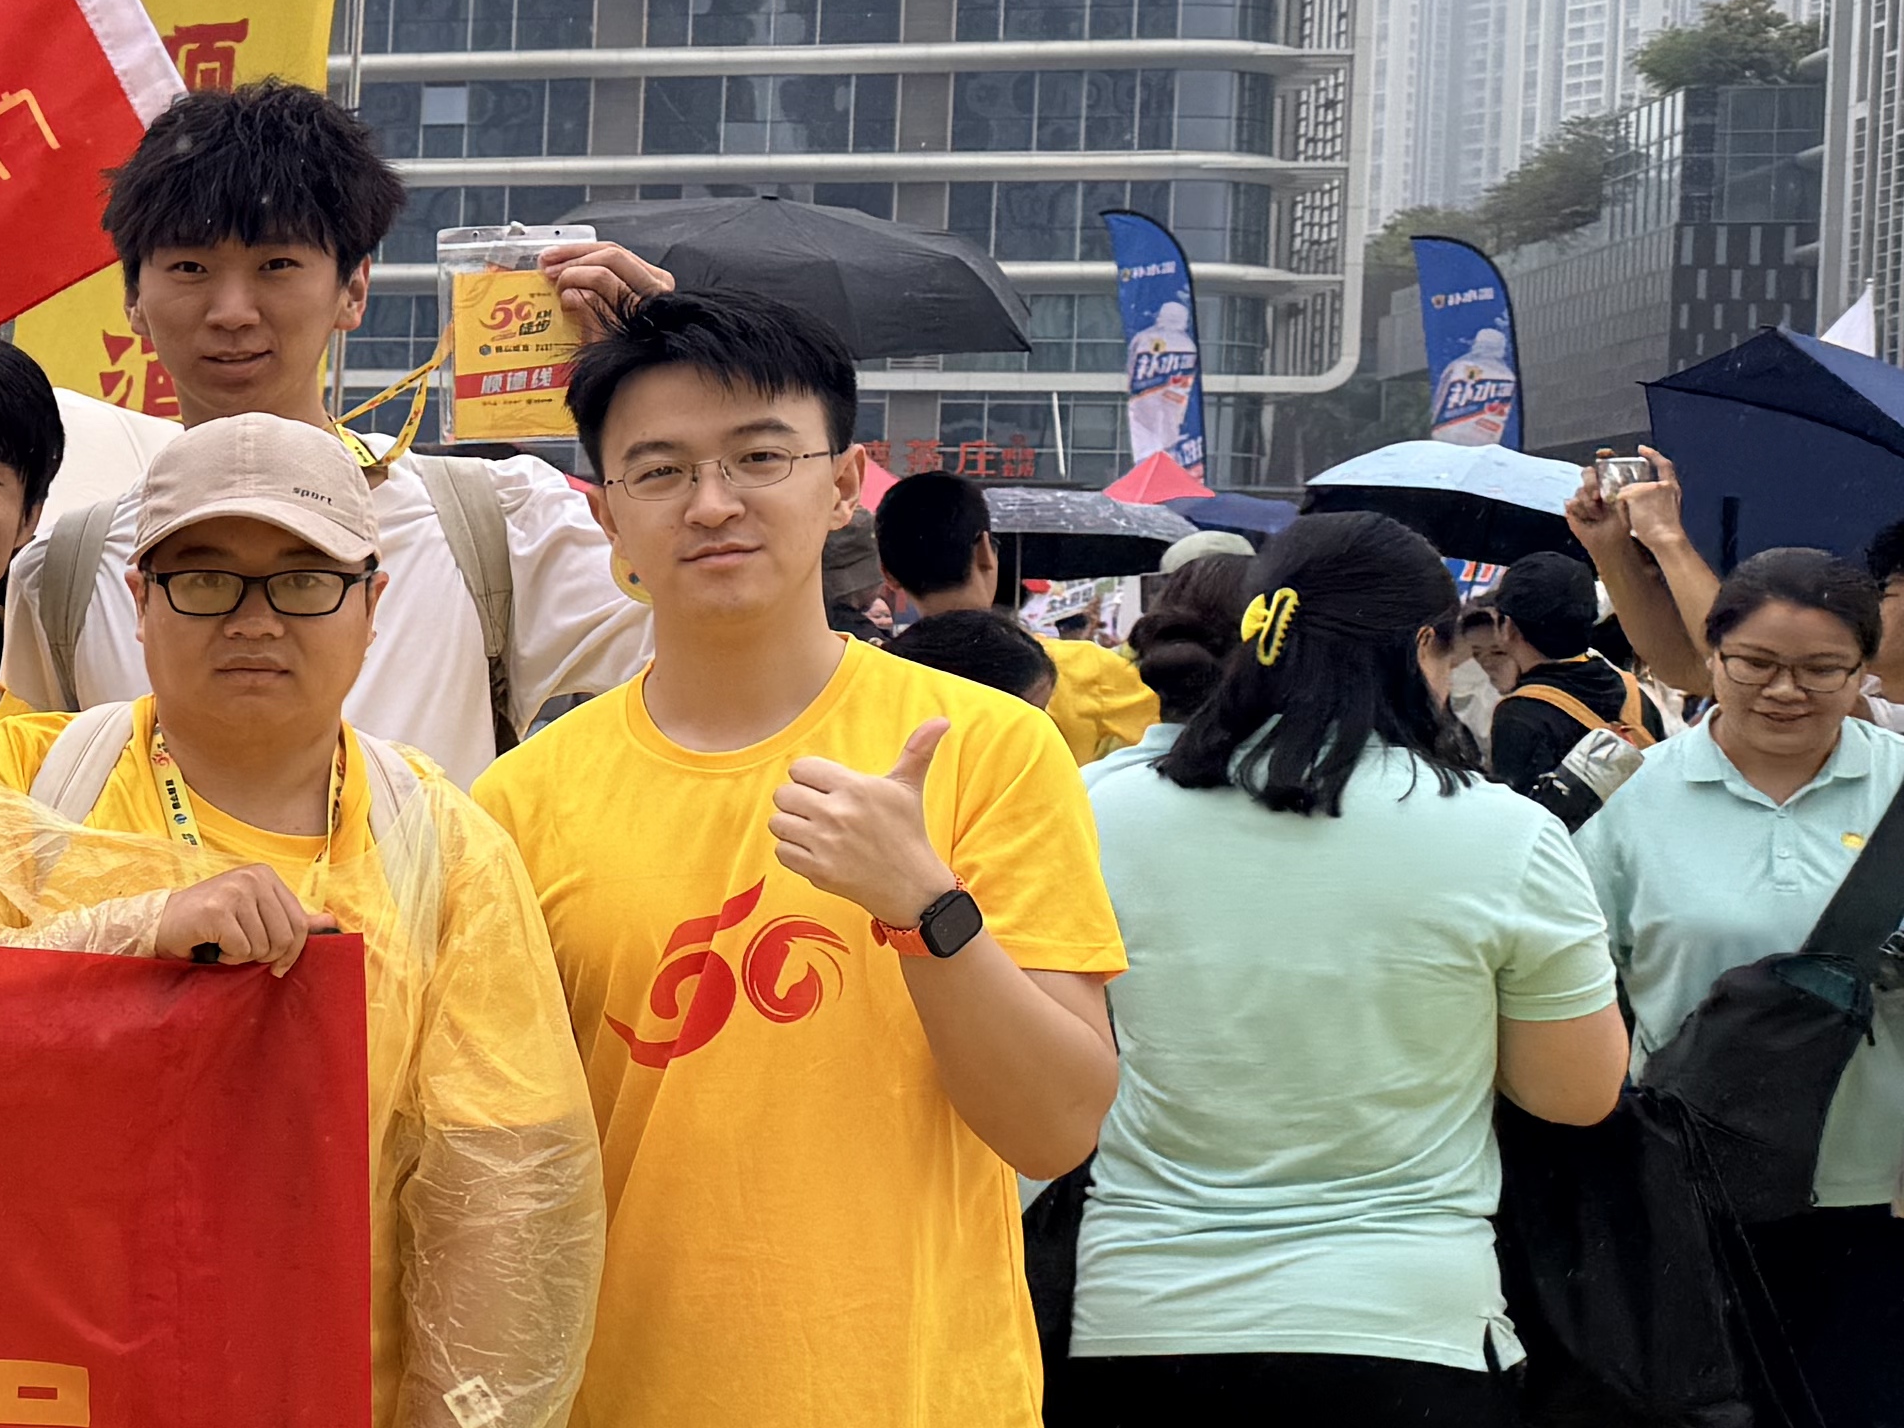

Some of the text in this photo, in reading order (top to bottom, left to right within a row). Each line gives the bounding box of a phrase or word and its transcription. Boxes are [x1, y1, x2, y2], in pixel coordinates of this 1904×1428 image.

[480, 366, 553, 395] 顺德线
[291, 485, 334, 508] sport
